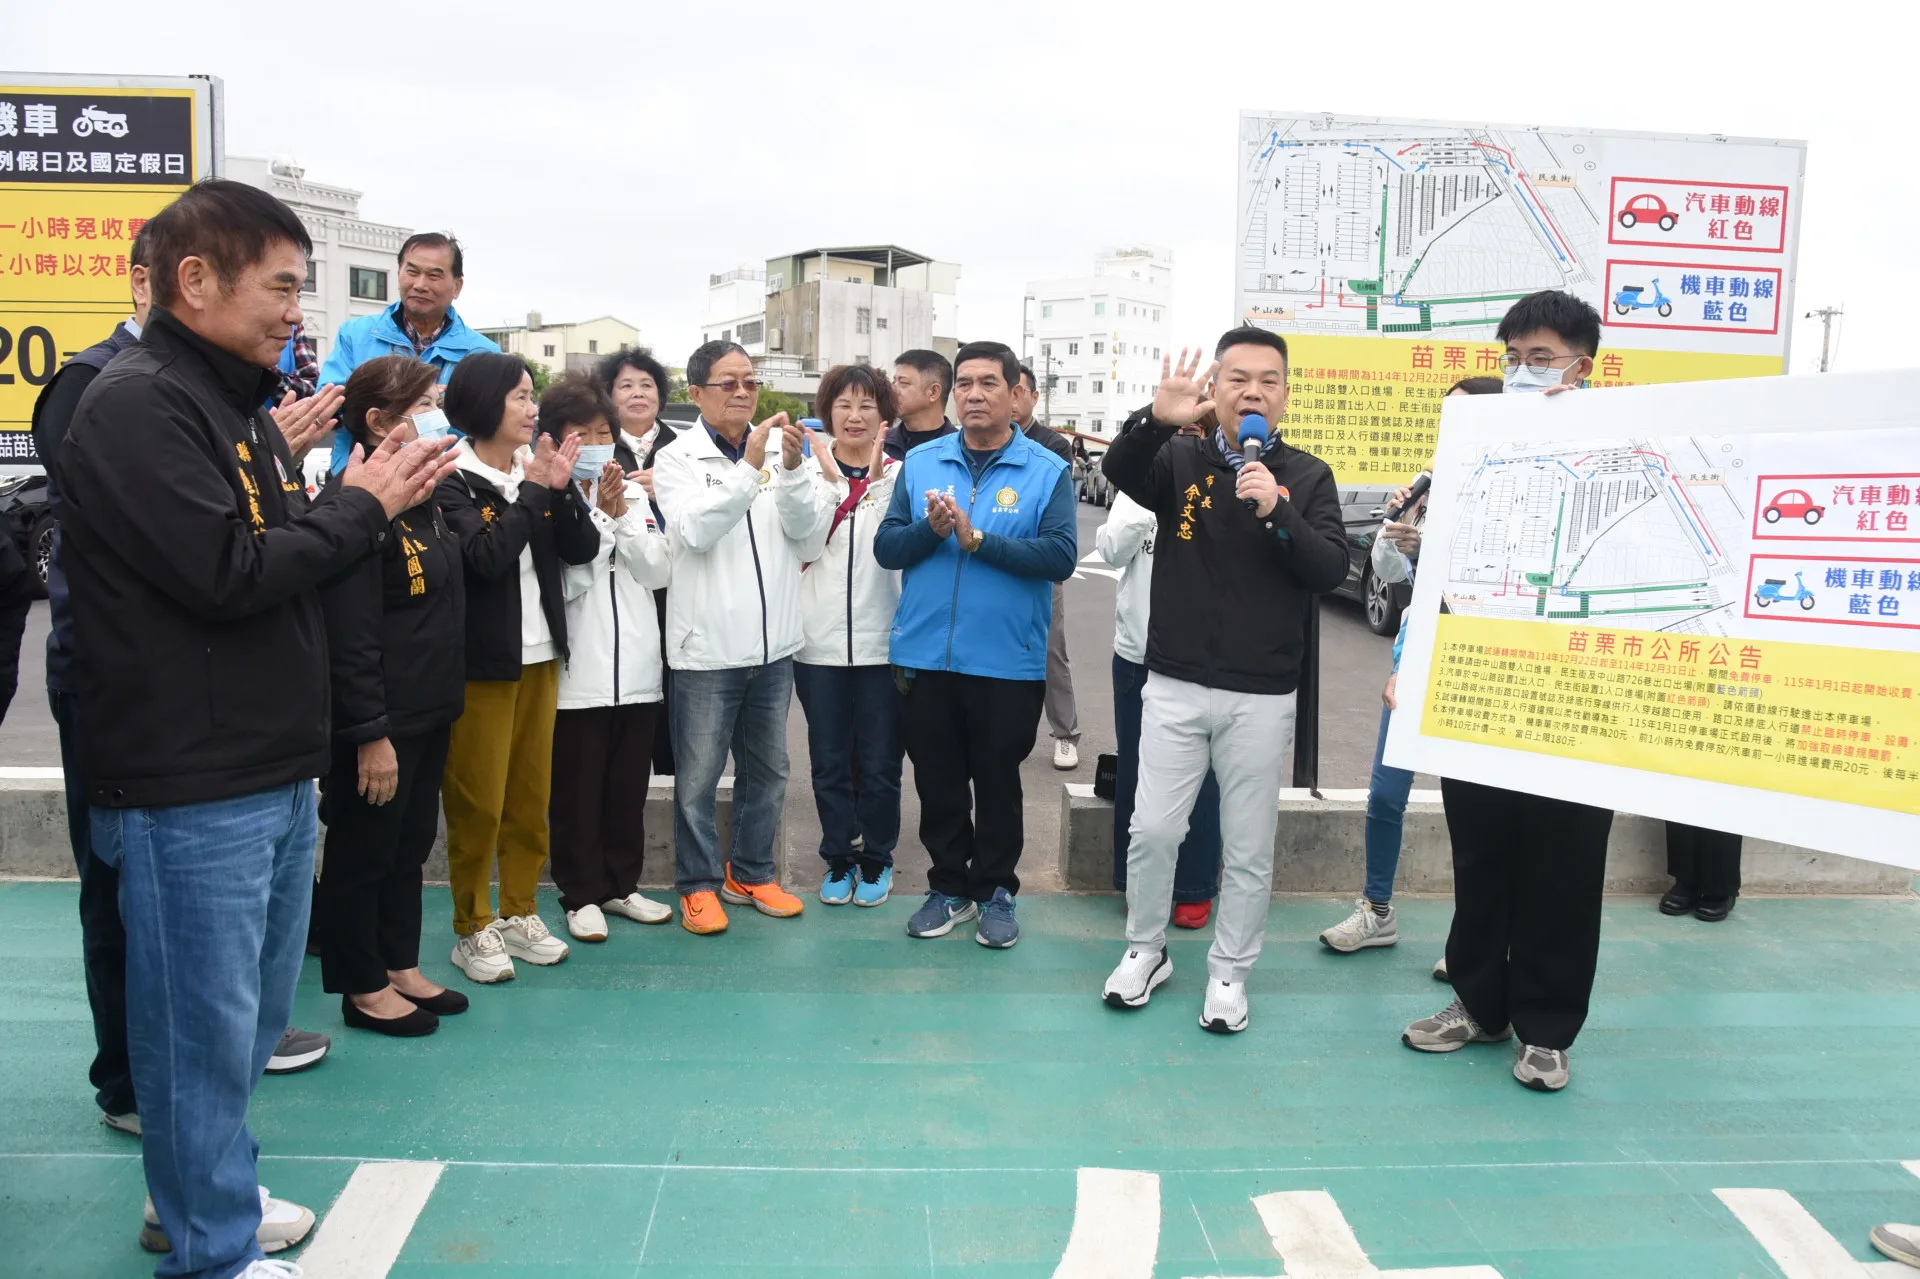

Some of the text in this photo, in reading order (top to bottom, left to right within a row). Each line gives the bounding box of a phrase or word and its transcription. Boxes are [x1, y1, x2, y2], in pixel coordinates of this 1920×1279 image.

[1685, 192, 1779, 217] 汽車動線
[1708, 219, 1752, 240] 紅色
[1680, 274, 1773, 298] 機車動線
[1252, 305, 1284, 315] 中山路
[1703, 300, 1747, 322] 藍色
[1201, 475, 1215, 508] 市長
[1832, 484, 1920, 505] 汽車動
[1176, 484, 1201, 540] 余文忠
[1856, 510, 1908, 531] 紅色
[1848, 594, 1899, 616] 藍色
[1568, 630, 1762, 669] 苗栗市公所公告
